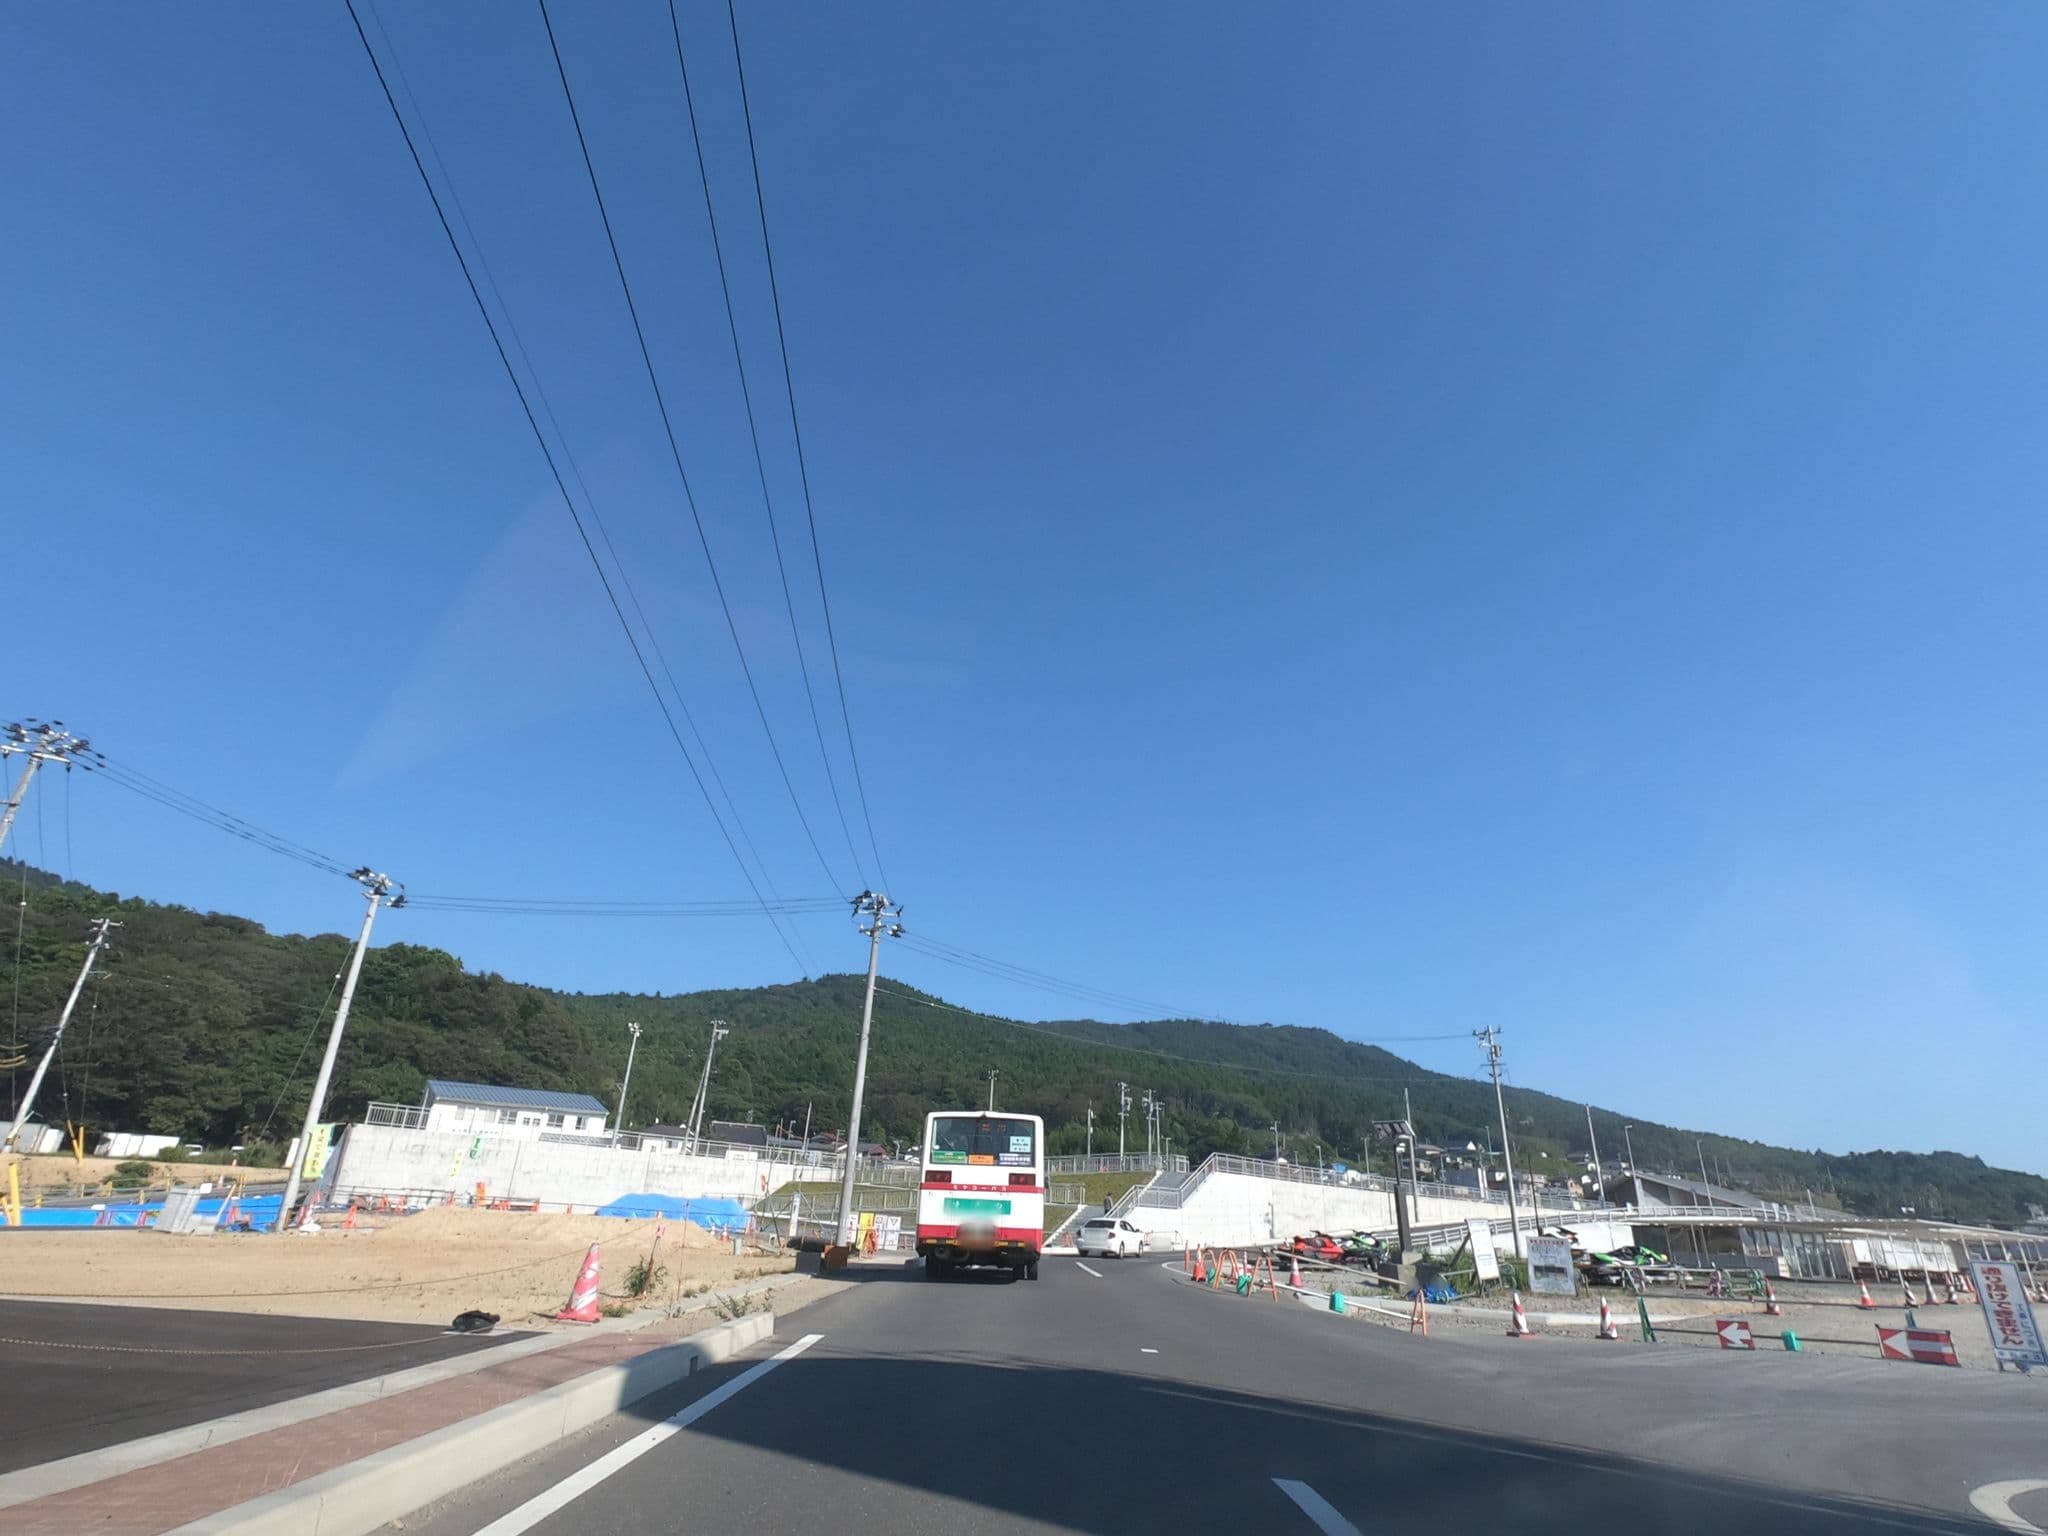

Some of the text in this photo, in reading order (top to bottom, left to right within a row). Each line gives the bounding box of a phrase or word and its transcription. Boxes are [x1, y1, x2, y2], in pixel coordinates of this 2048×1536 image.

[1982, 1267, 2025, 1345] 通り抜けできません
